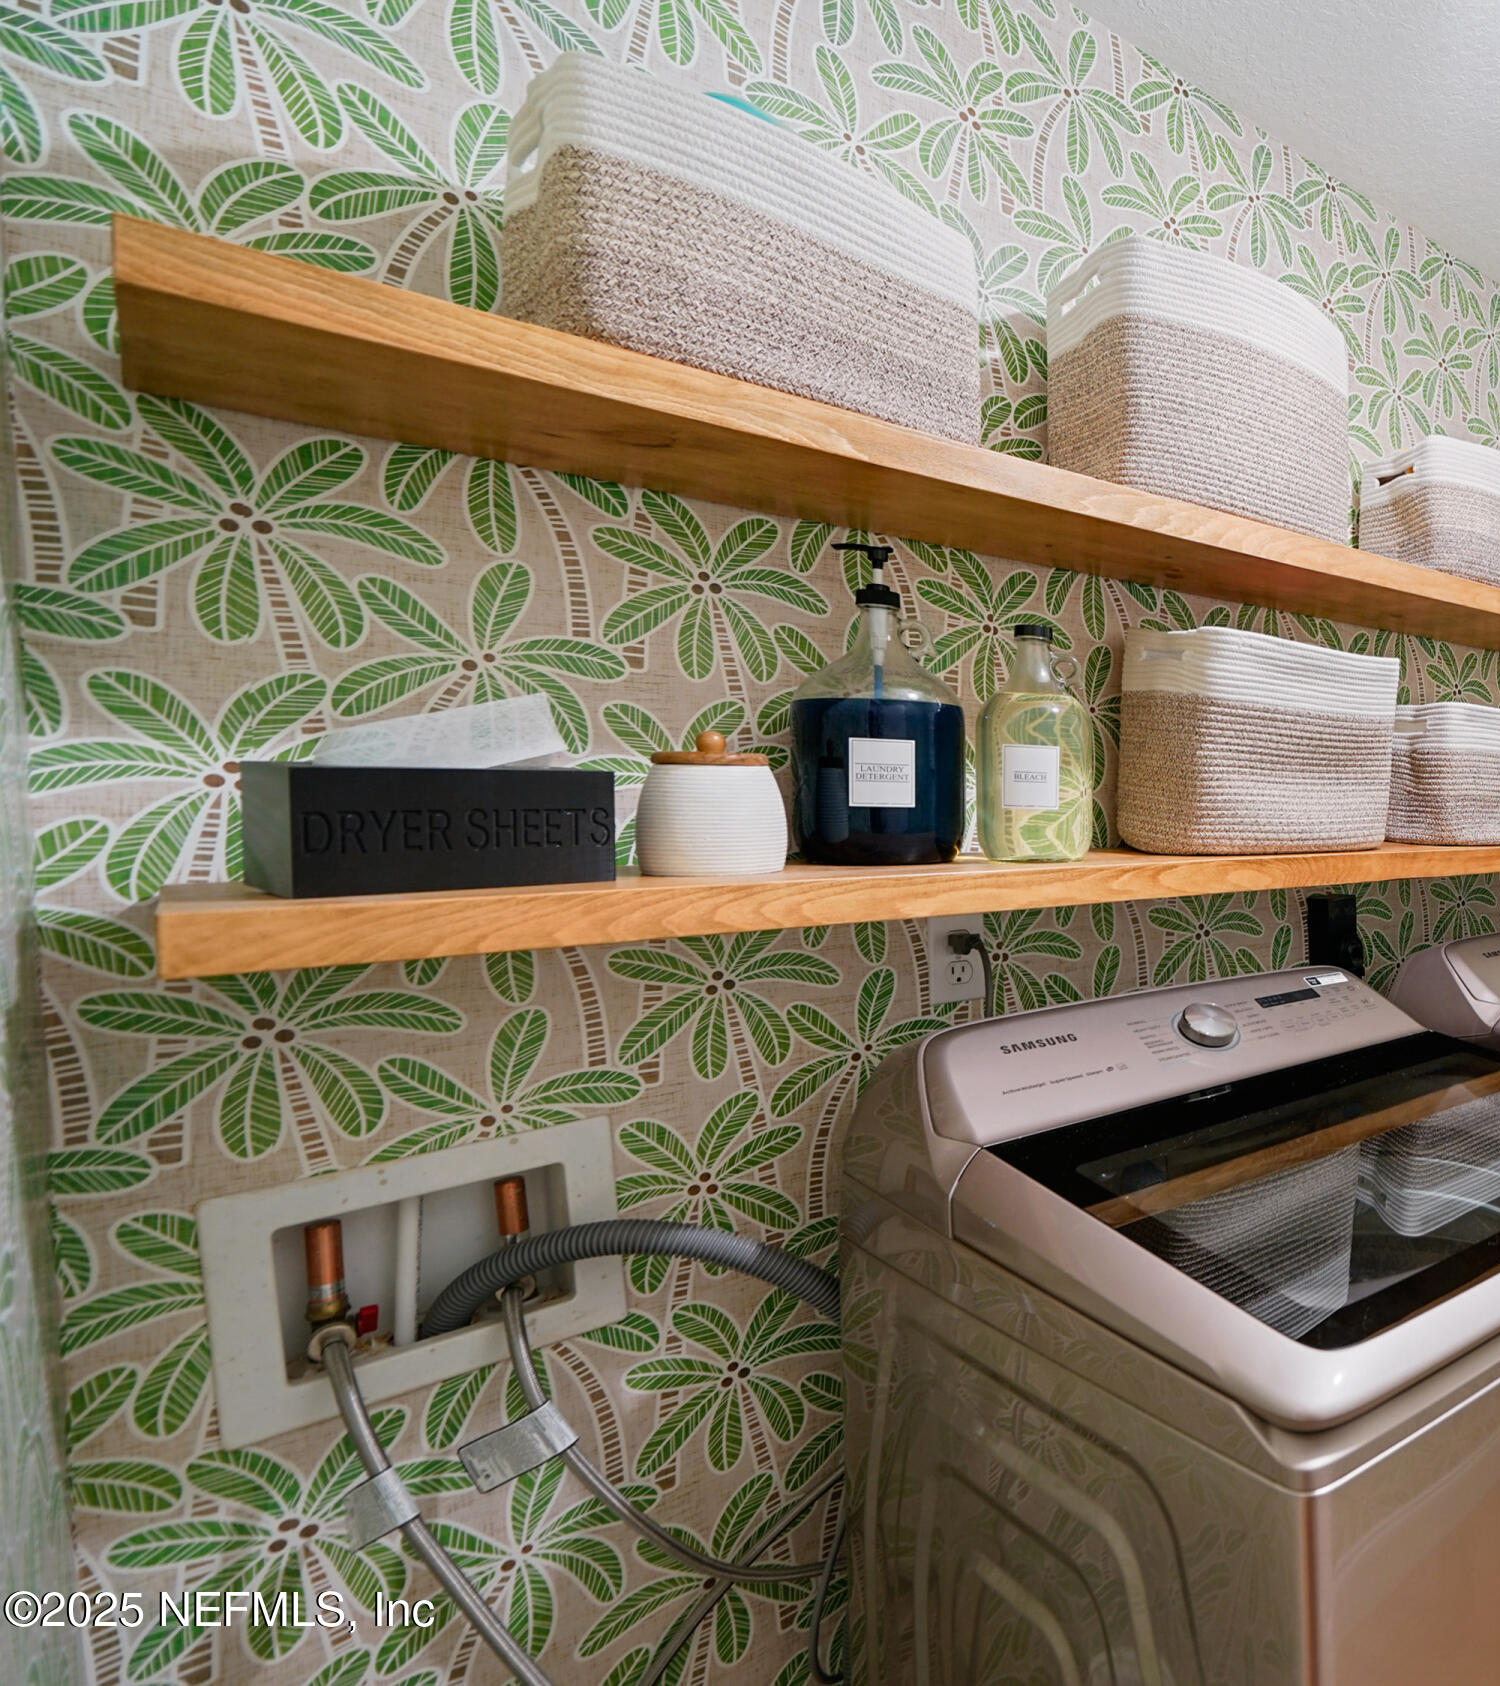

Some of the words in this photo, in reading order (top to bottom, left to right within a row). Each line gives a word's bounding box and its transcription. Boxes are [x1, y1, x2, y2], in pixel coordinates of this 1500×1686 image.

[860, 764, 905, 773] LAUNDRY
[855, 773, 910, 781] DETERGENT
[1013, 773, 1047, 781] BLEACH
[302, 809, 452, 854] DRYER
[465, 807, 610, 848] SHEETS
[1000, 1033, 1078, 1055] SAMSUNG
